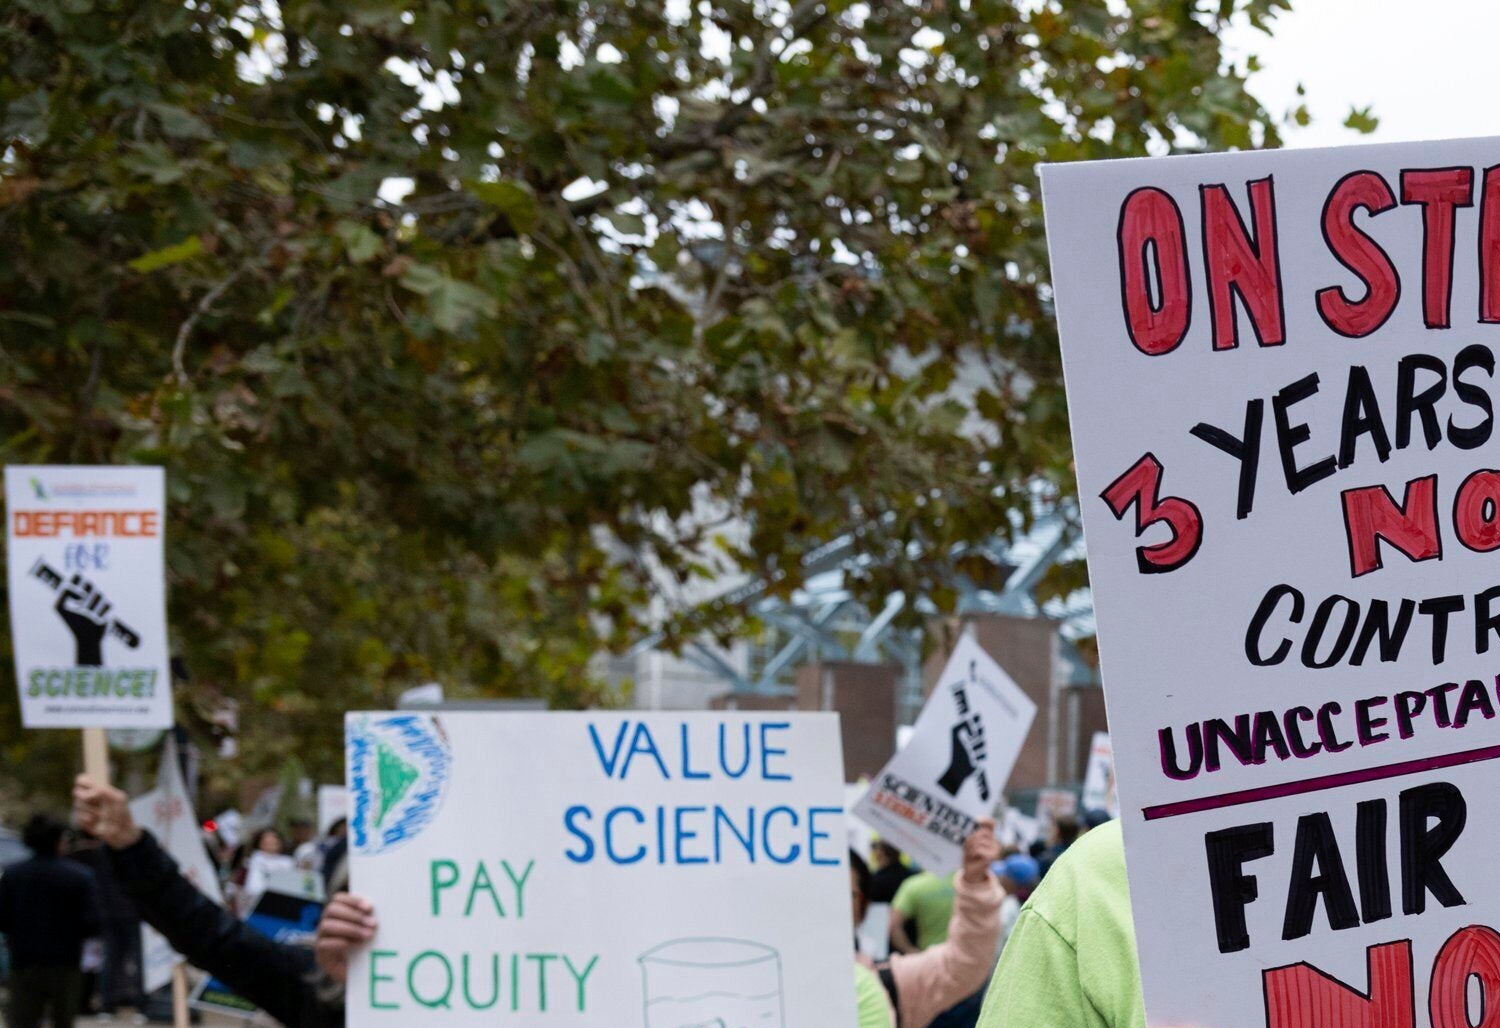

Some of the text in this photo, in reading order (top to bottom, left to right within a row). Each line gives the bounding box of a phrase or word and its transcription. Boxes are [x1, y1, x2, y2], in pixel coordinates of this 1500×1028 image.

[1117, 174, 1285, 356] ON
[1100, 452, 1203, 575] 3
[1189, 344, 1496, 520] YEARS
[13, 510, 157, 538] DEFIANCE
[28, 667, 158, 699] SCIENCE!
[588, 720, 793, 781] VALUE
[563, 804, 844, 866] SCIENCE
[429, 859, 536, 919] PAY
[1204, 781, 1467, 954] FAIR
[369, 950, 600, 1012] EQUITY
